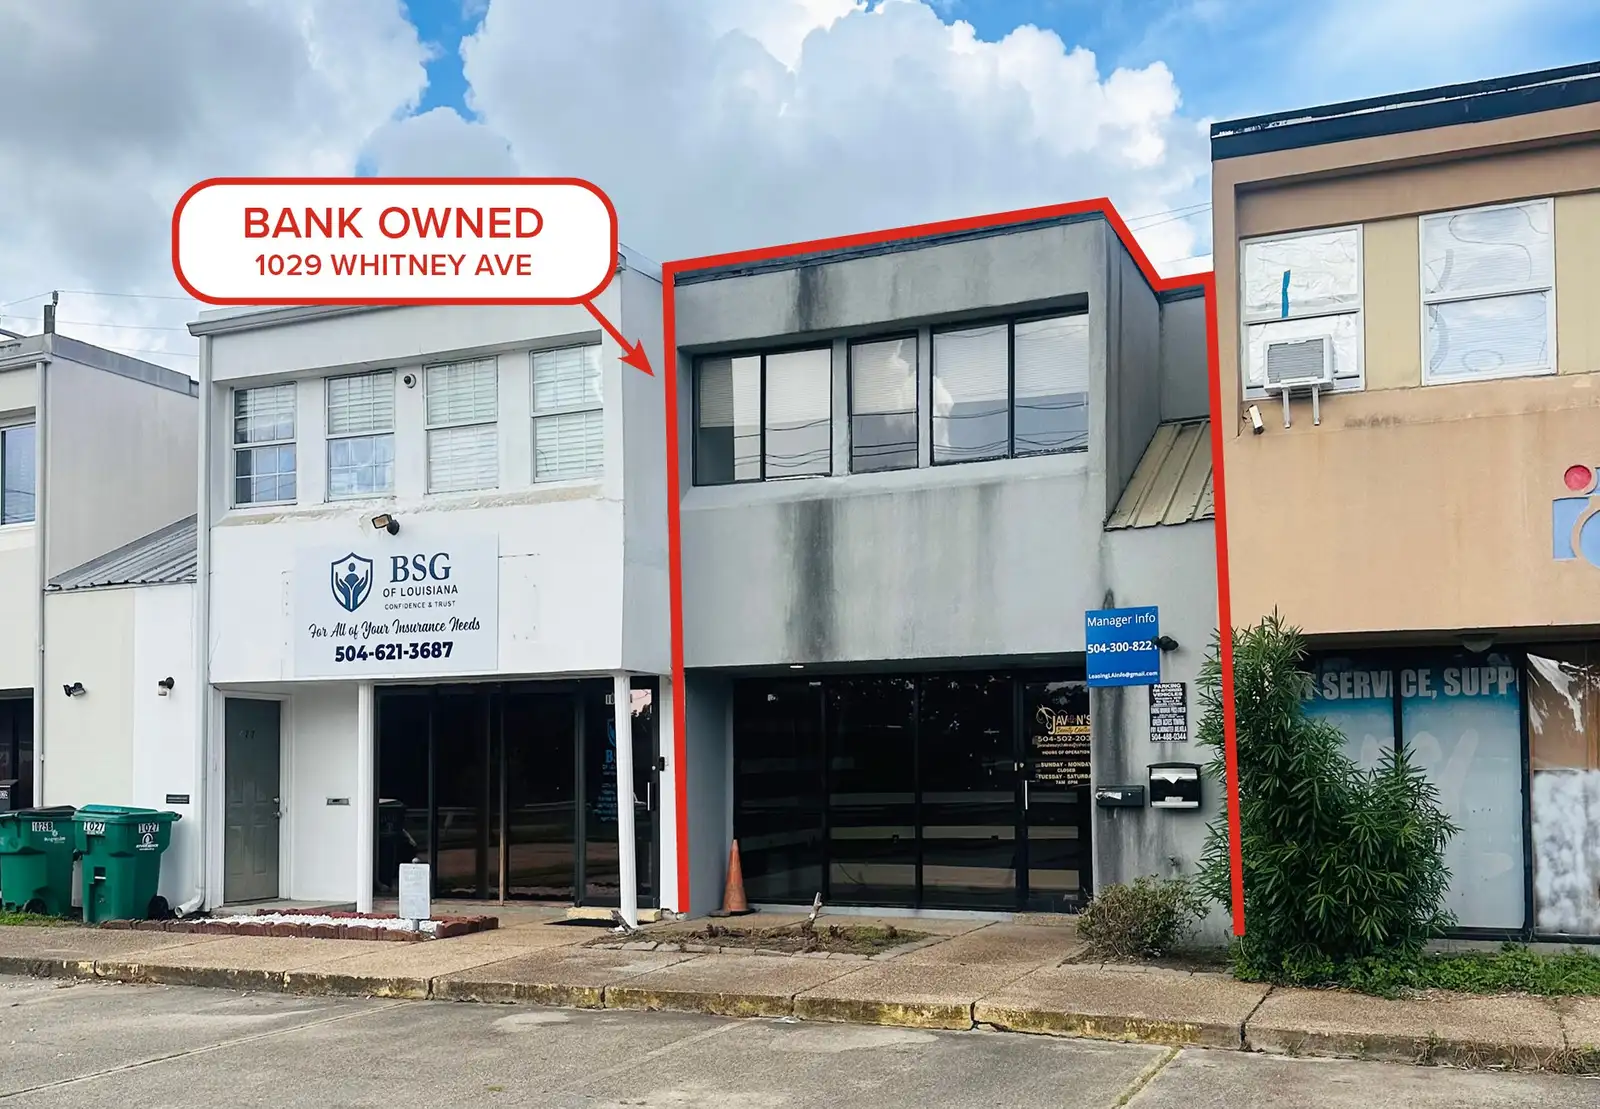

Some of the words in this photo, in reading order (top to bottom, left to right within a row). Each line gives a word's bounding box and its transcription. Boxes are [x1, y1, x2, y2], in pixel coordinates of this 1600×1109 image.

[390, 552, 452, 583] BSG
[383, 587, 397, 598] OF
[401, 584, 459, 597] LOUISIANA
[384, 602, 426, 611] CONFIDENCE
[434, 600, 456, 608] TRUST
[308, 623, 328, 639] For
[330, 621, 347, 638] All
[348, 623, 360, 640] of
[360, 621, 390, 640] Your
[392, 618, 446, 636] Insurance
[448, 616, 481, 632] Needs
[1087, 616, 1132, 628] Manager
[1135, 612, 1156, 624] Info
[334, 641, 454, 663] 504-621-3687
[1444, 667, 1519, 697] SUPP
[84, 822, 105, 832] 1027
[139, 823, 159, 833] 1027
